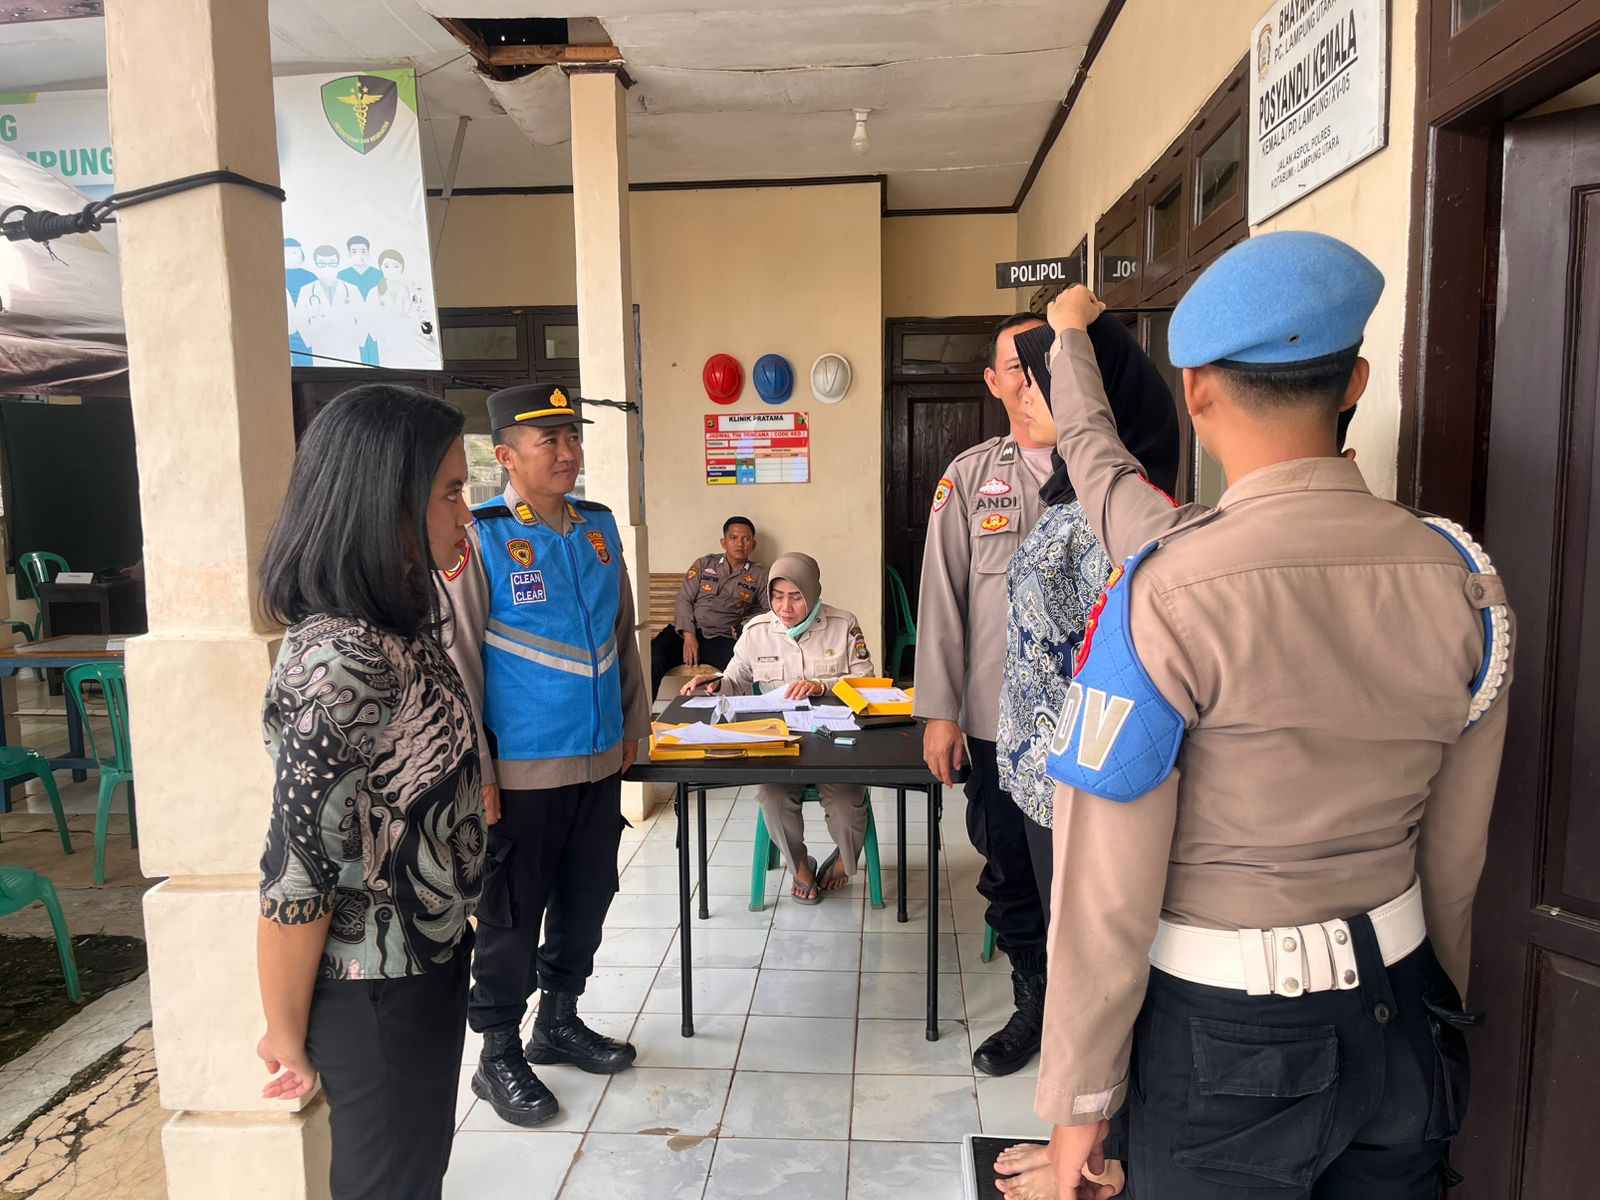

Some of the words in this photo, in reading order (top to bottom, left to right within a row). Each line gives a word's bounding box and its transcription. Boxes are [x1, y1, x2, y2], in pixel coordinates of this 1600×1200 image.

[1285, 10, 1316, 54] LAMPUNG
[1259, 53, 1310, 136] POSYANDU
[1313, 8, 1357, 91] KEMALA
[1010, 262, 1066, 283] POLIPOL
[729, 415, 752, 423] KLINIK
[753, 414, 784, 422] PRATAMA
[976, 496, 1017, 510] ANDI
[513, 573, 541, 585] CLEAN
[515, 589, 545, 601] CLEAR
